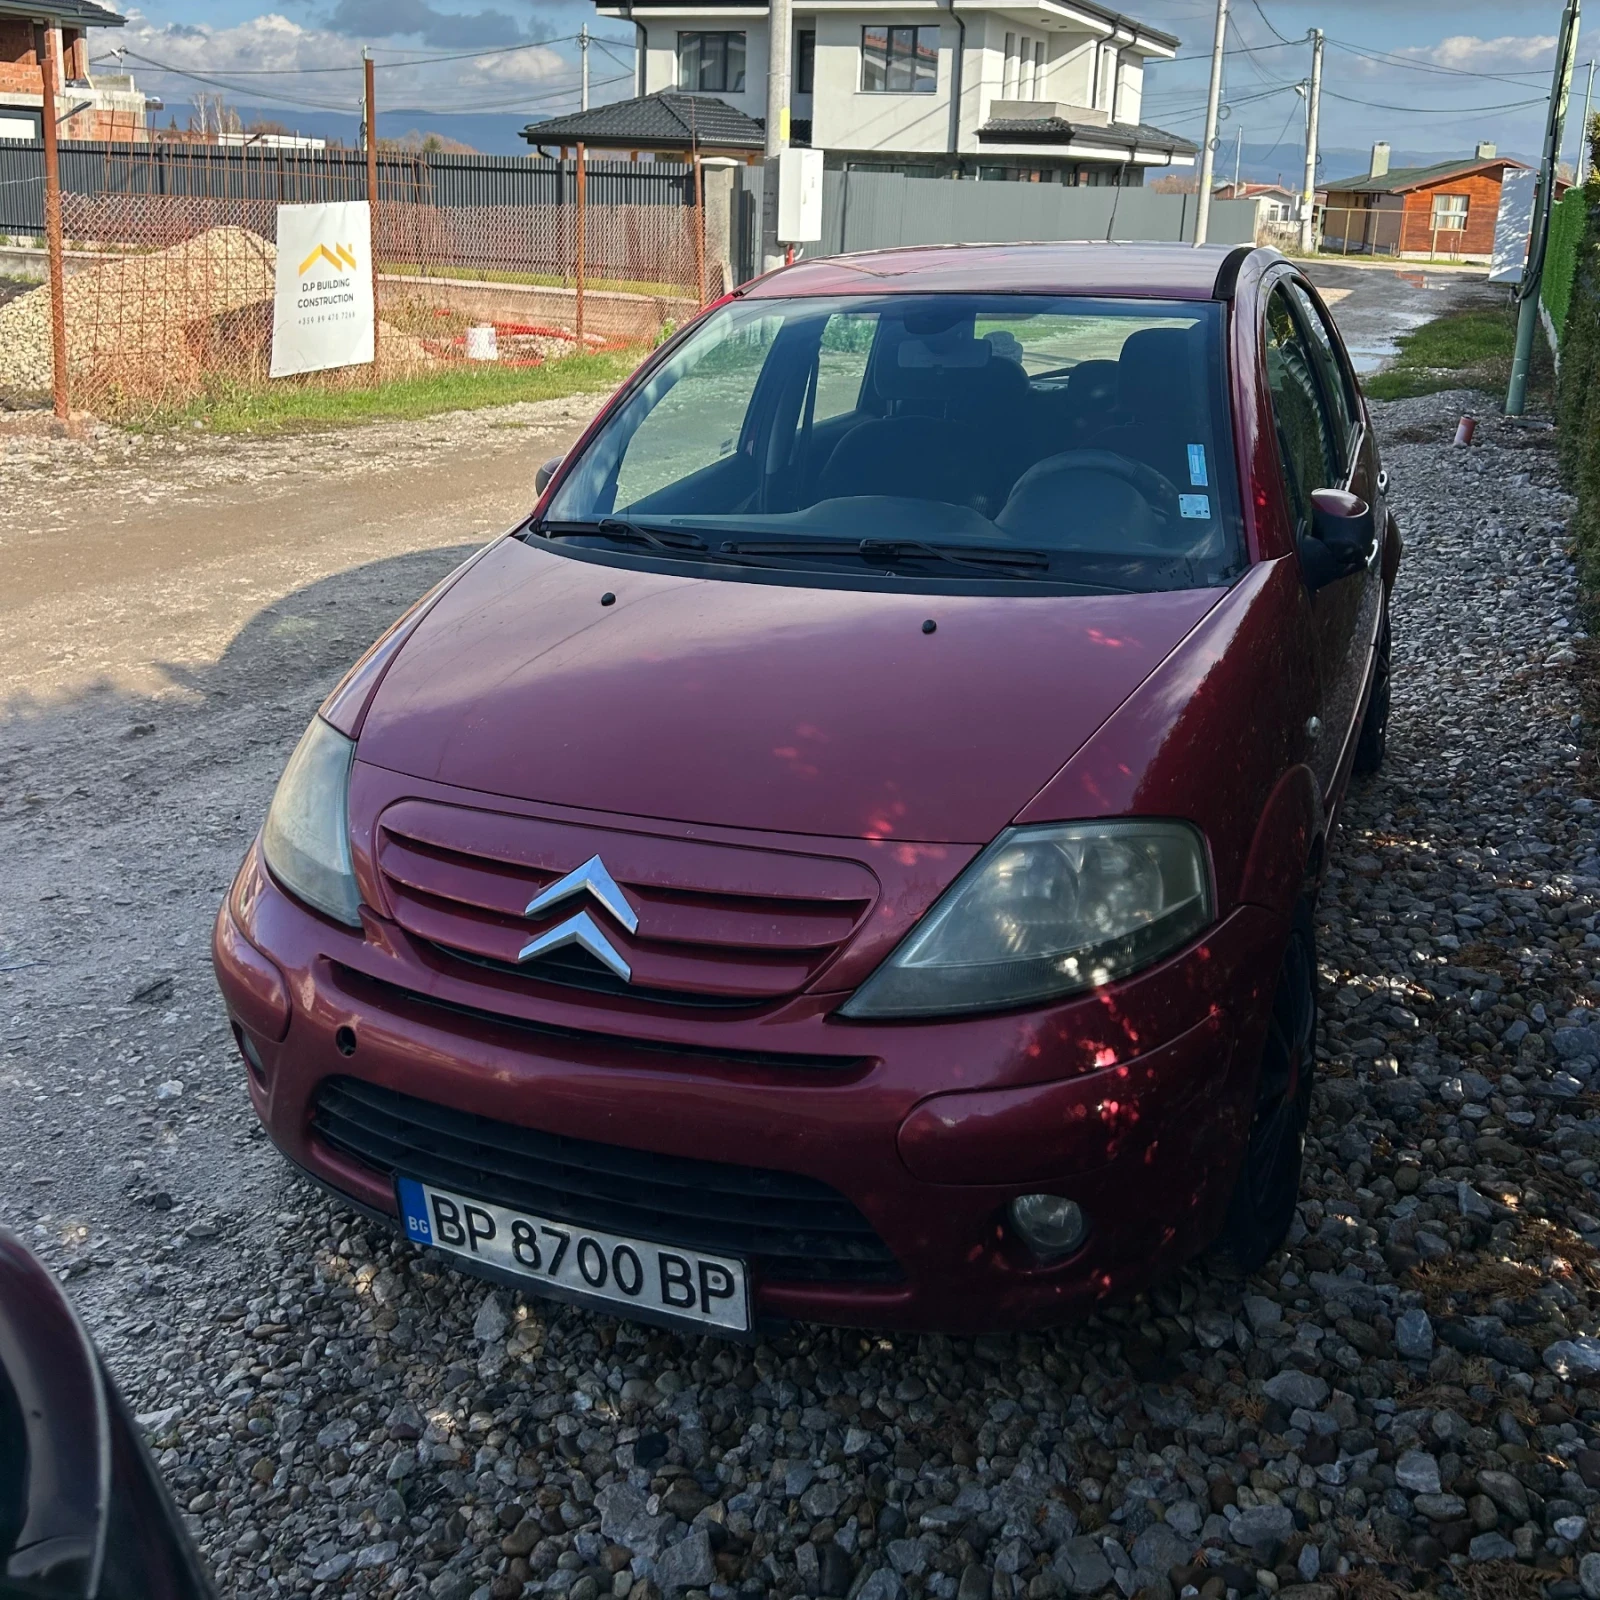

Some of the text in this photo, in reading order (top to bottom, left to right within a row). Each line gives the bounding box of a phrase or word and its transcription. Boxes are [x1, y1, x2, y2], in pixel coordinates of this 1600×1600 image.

[302, 278, 350, 292] D.P BUILDING
[297, 293, 353, 308] CONSTRUCTION
[298, 316, 314, 325] +359
[407, 1215, 430, 1235] BG
[430, 1192, 736, 1315] BP 8700 BP
